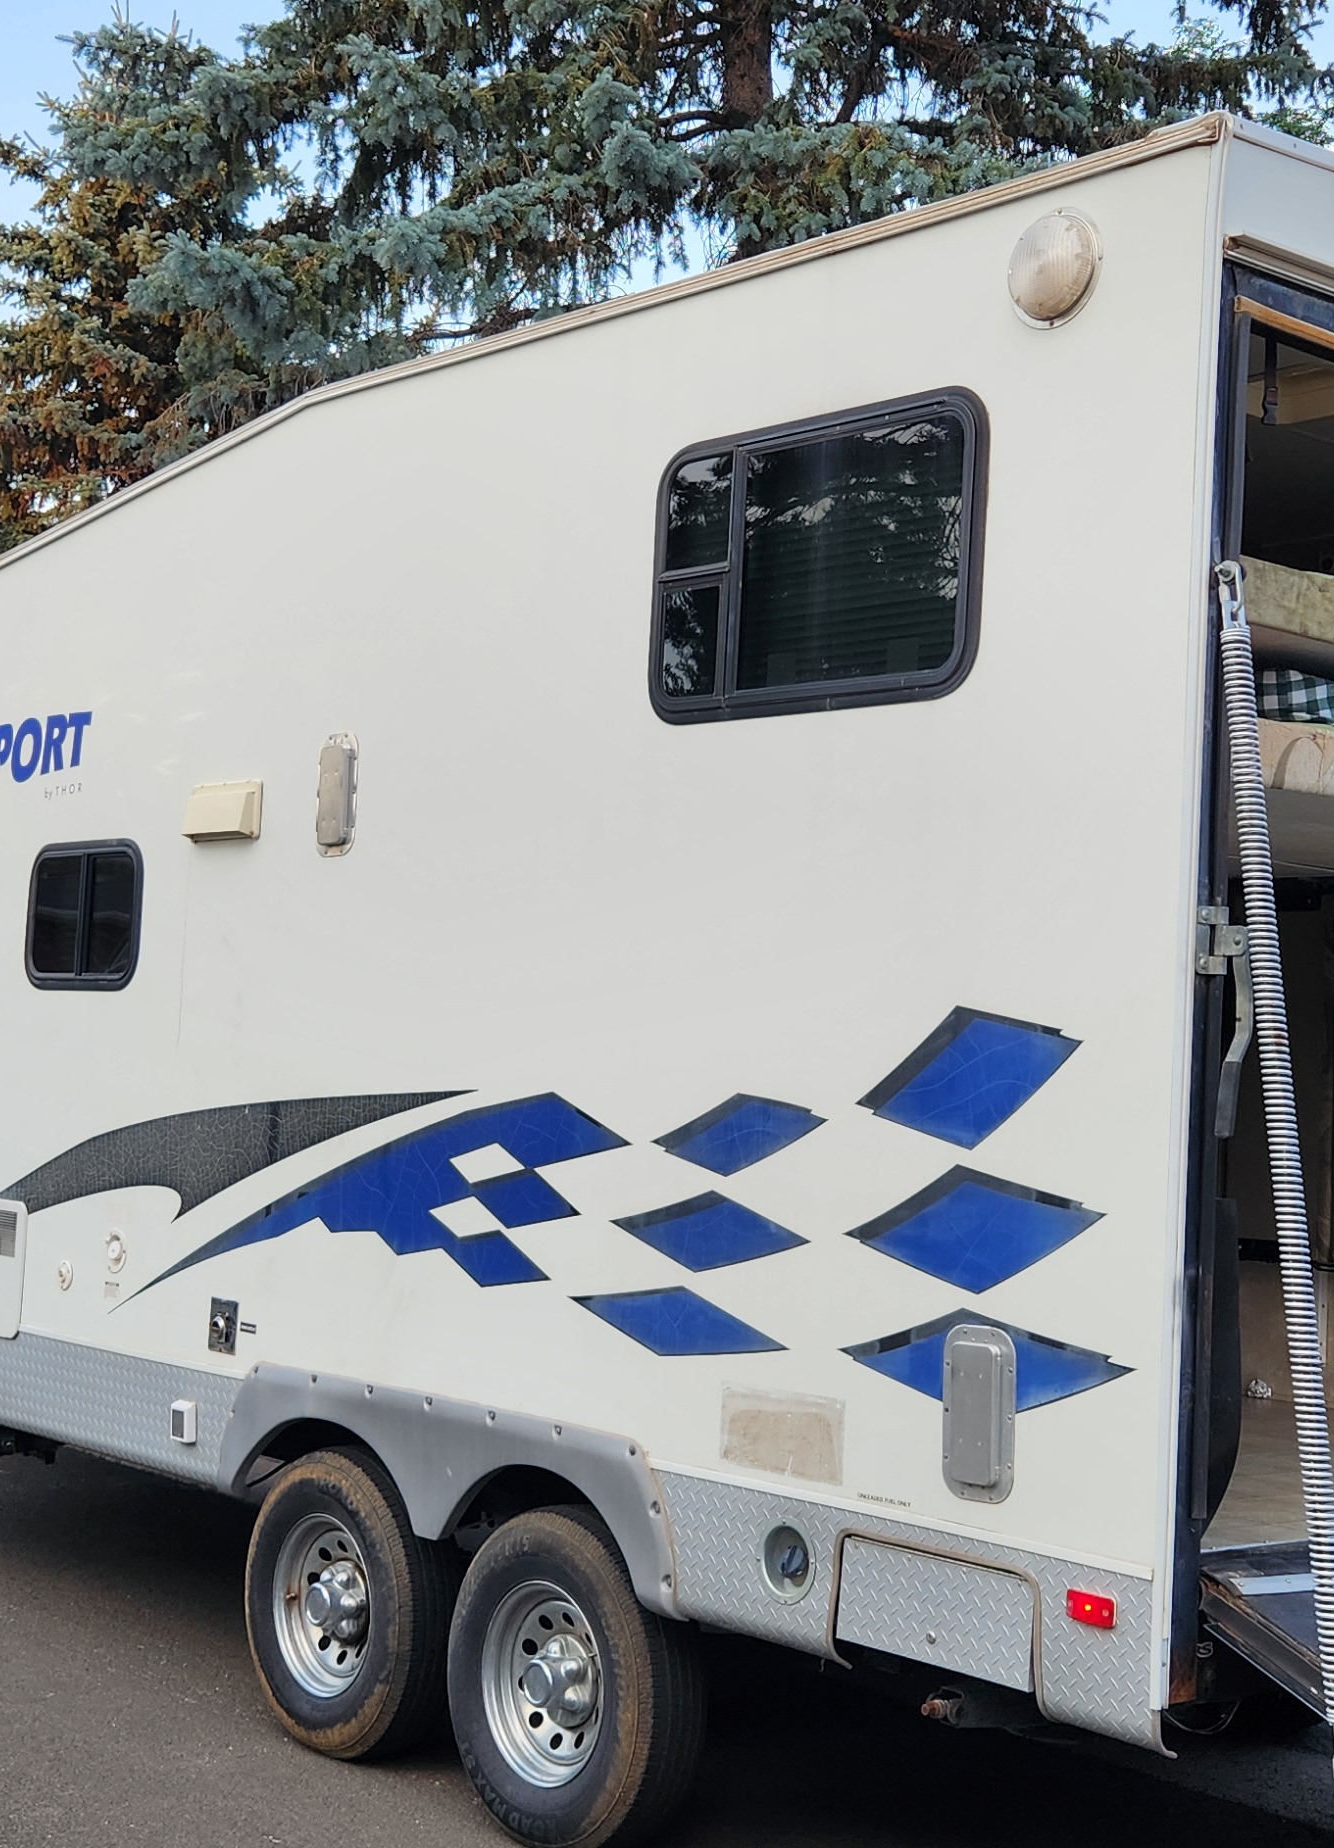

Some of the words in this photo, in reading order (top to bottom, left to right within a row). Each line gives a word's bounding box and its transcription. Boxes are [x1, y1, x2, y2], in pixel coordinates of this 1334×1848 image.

[55, 782, 83, 797] THOR
[884, 1497, 896, 1505] FUEL
[896, 1500, 911, 1508] ONLY
